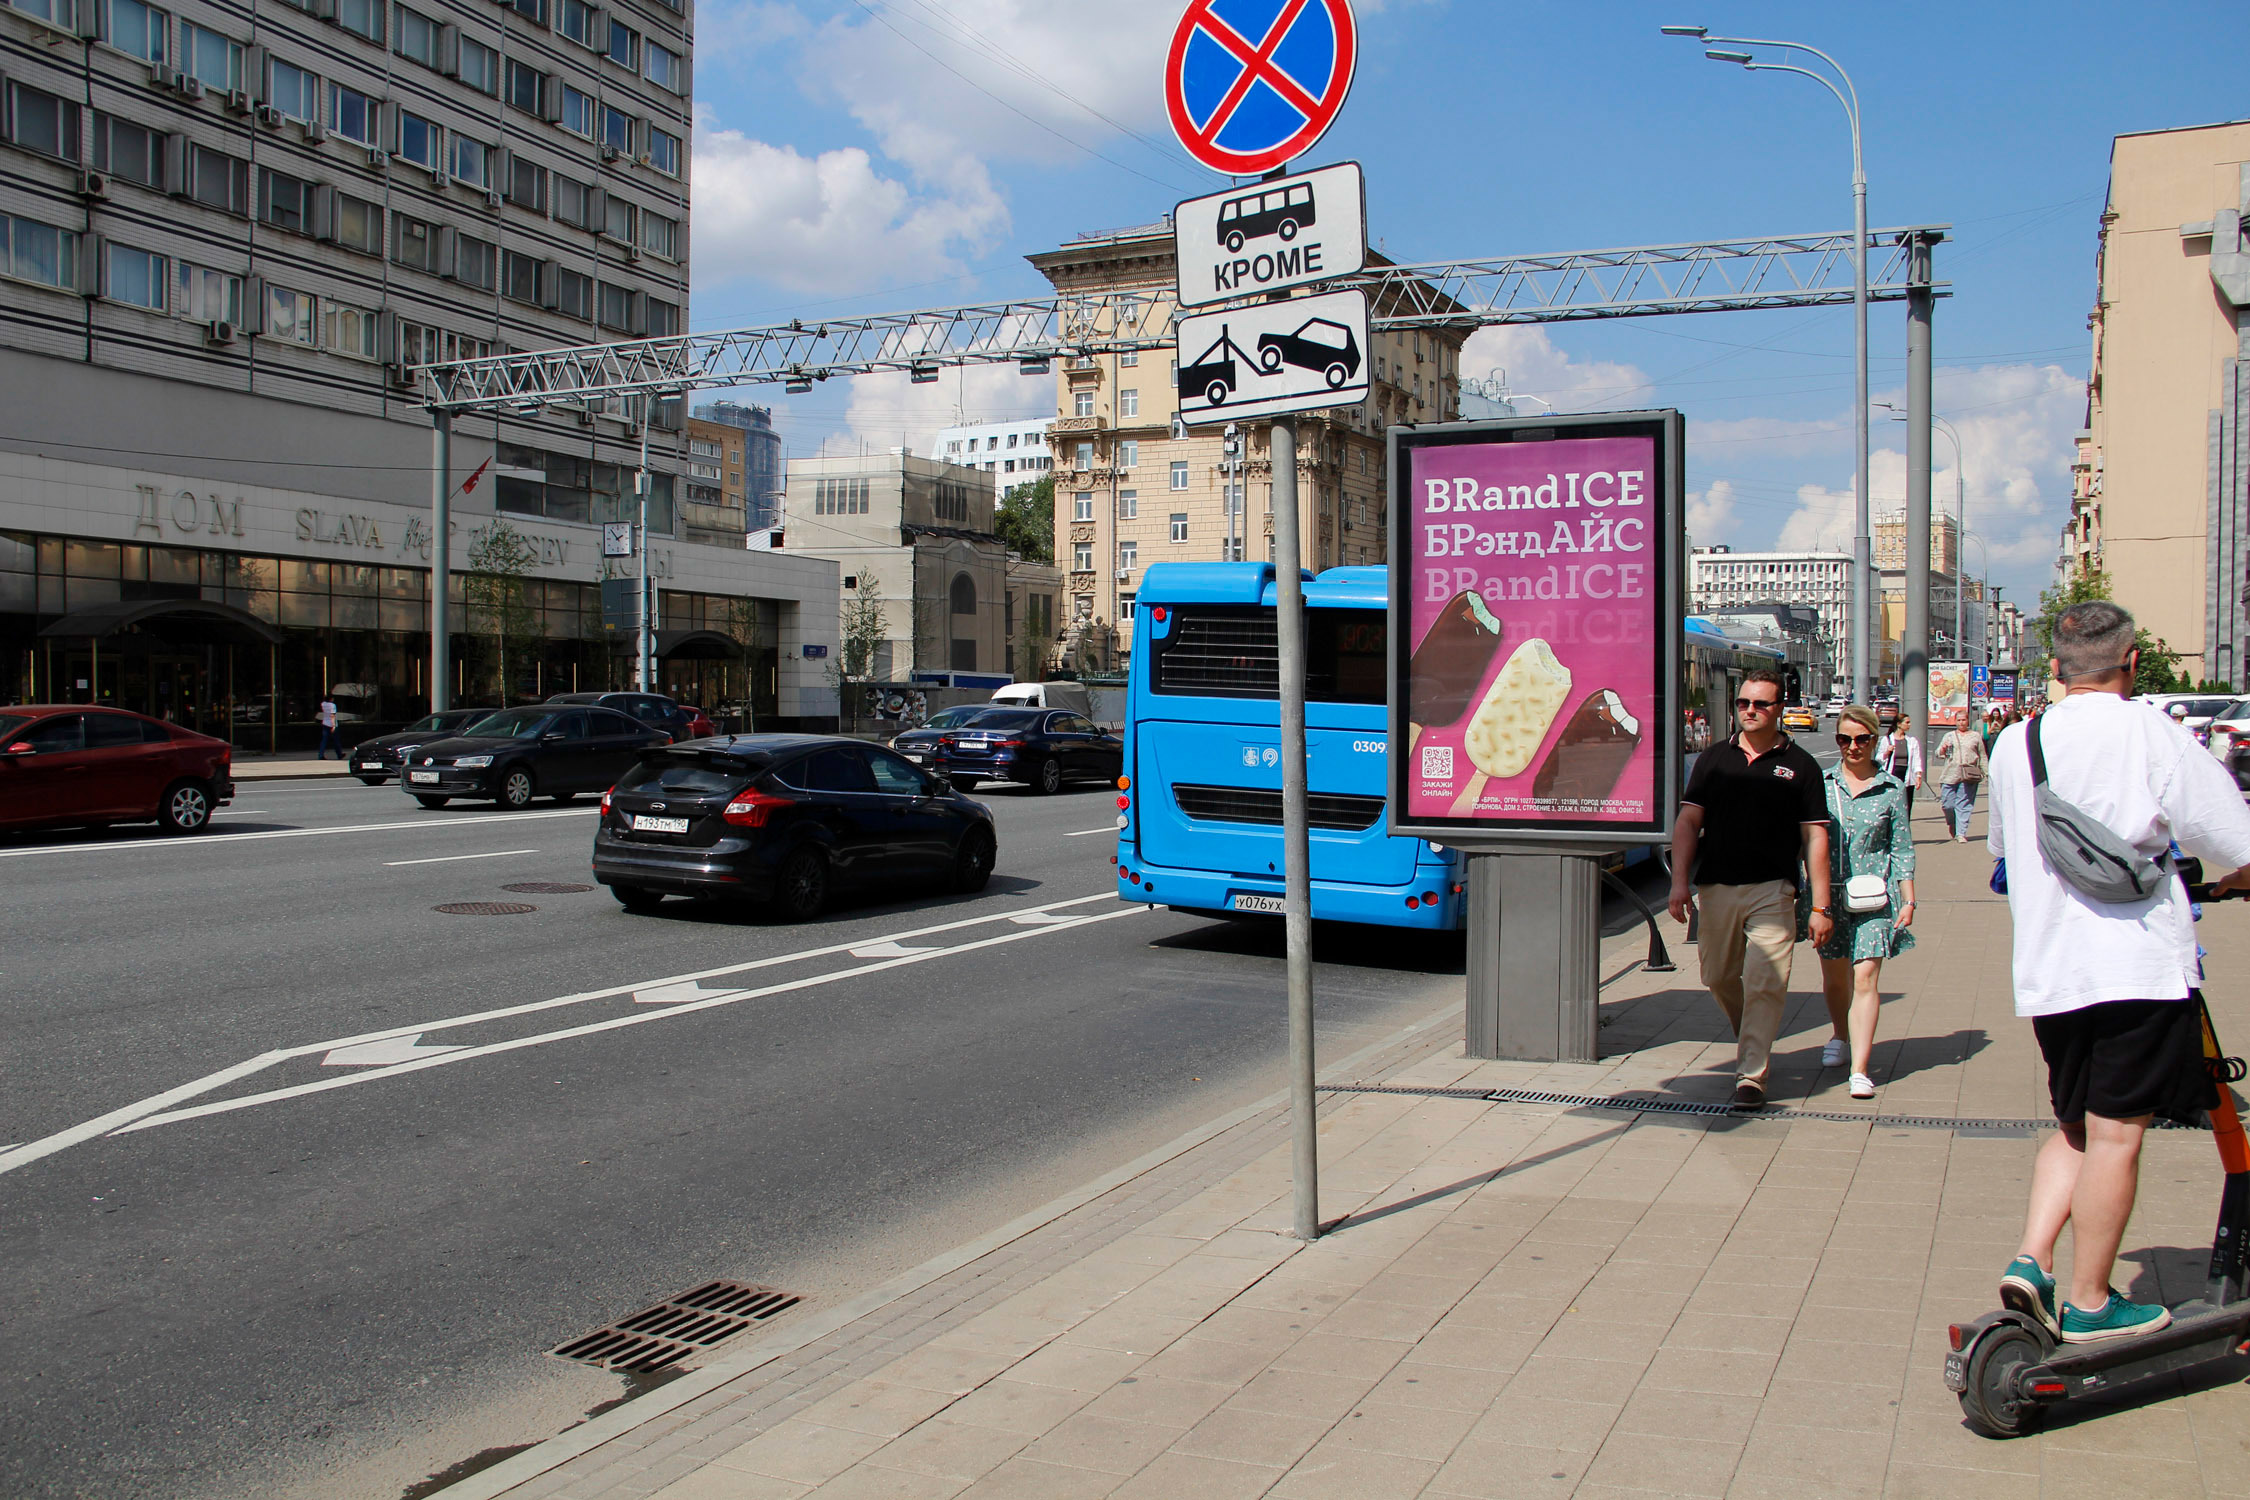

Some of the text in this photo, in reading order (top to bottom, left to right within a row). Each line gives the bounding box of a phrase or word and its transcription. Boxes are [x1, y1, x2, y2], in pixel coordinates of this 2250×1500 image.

[1214, 243, 1323, 291] КРОМЕ
[1424, 470, 1644, 513] BRandICE
[133, 483, 245, 538] ДОМ
[296, 507, 384, 548] SLAVA
[1424, 511, 1644, 559] БРэндАЙС
[1353, 740, 1388, 753] 0309
[1421, 788, 1453, 797] ОНЛАЙН
[1522, 804, 1551, 812] СТРОЕНИЕ
[1618, 807, 1635, 815] ОФИС
[1580, 798, 1599, 806] ГОРОД
[1600, 799, 1625, 807] МОСКВА,
[637, 817, 686, 830] Н193ТМ 190
[1239, 896, 1282, 911] У076УХ
[1945, 1369, 1960, 1381] 472
